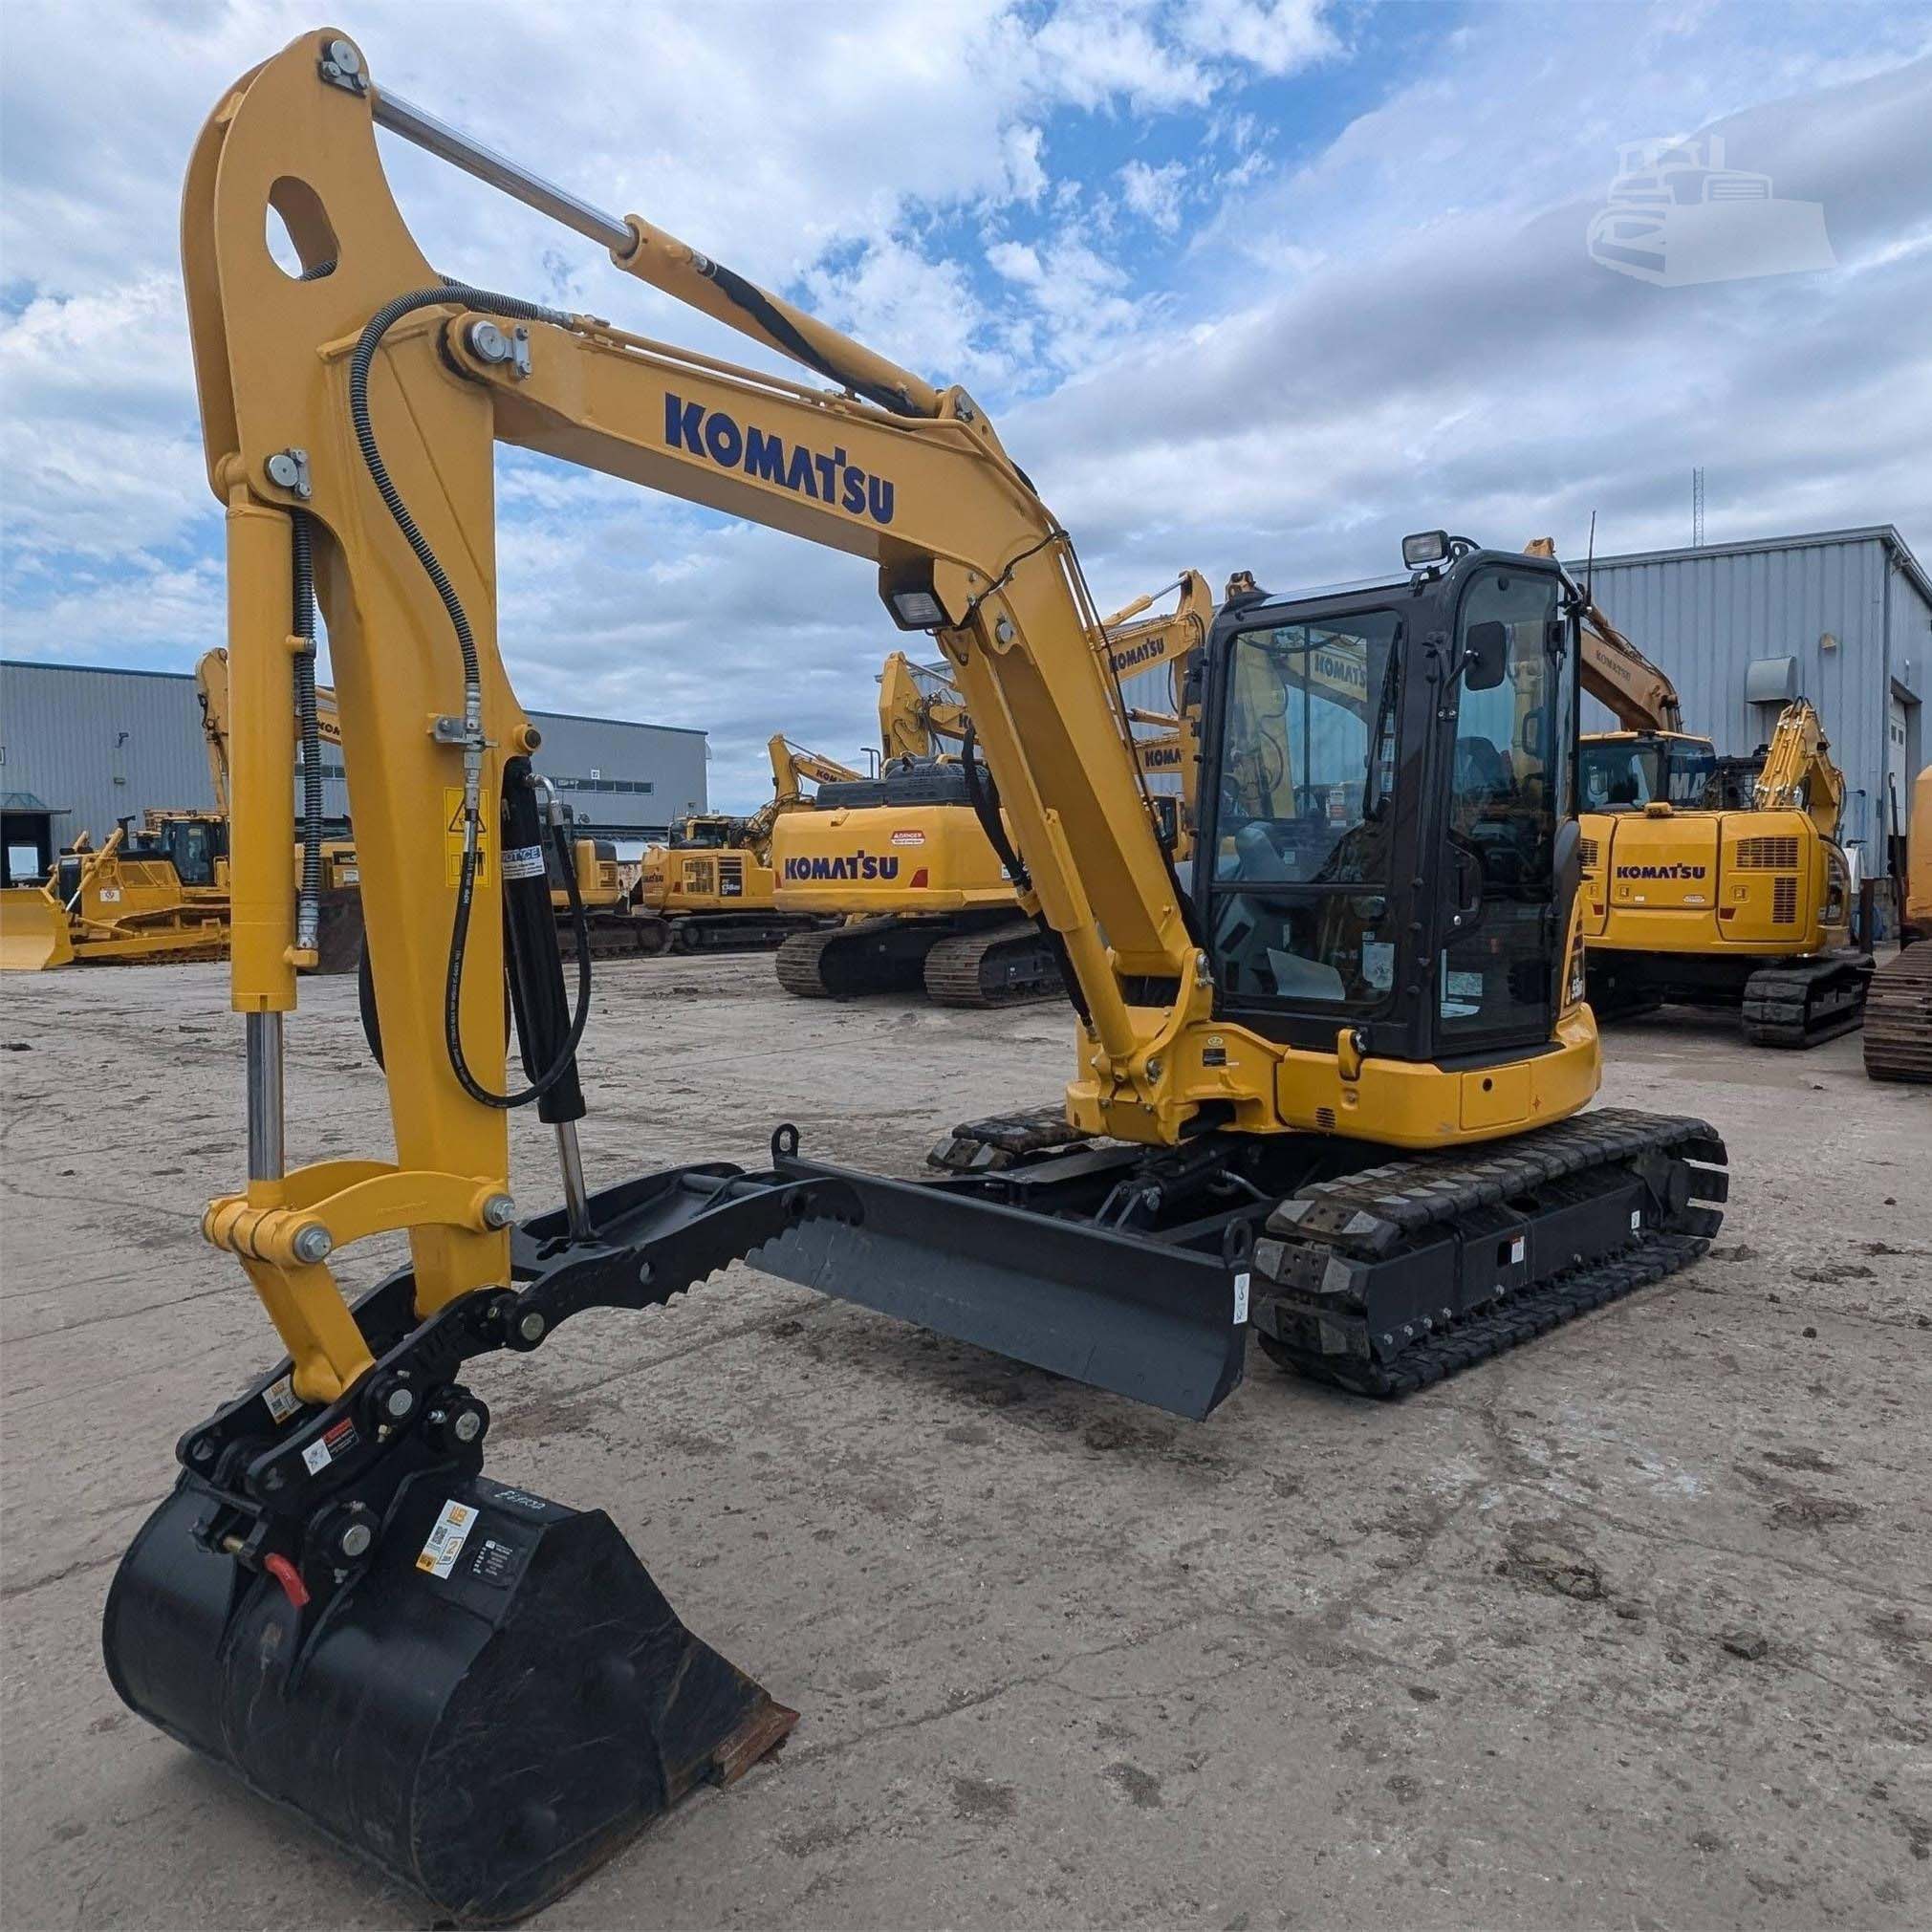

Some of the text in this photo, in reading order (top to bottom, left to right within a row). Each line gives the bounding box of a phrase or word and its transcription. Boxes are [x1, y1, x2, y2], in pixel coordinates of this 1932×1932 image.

[664, 391, 895, 525] KOMATSU
[784, 850, 899, 880] KOMATSU
[1617, 862, 1706, 879] KOMATSU
